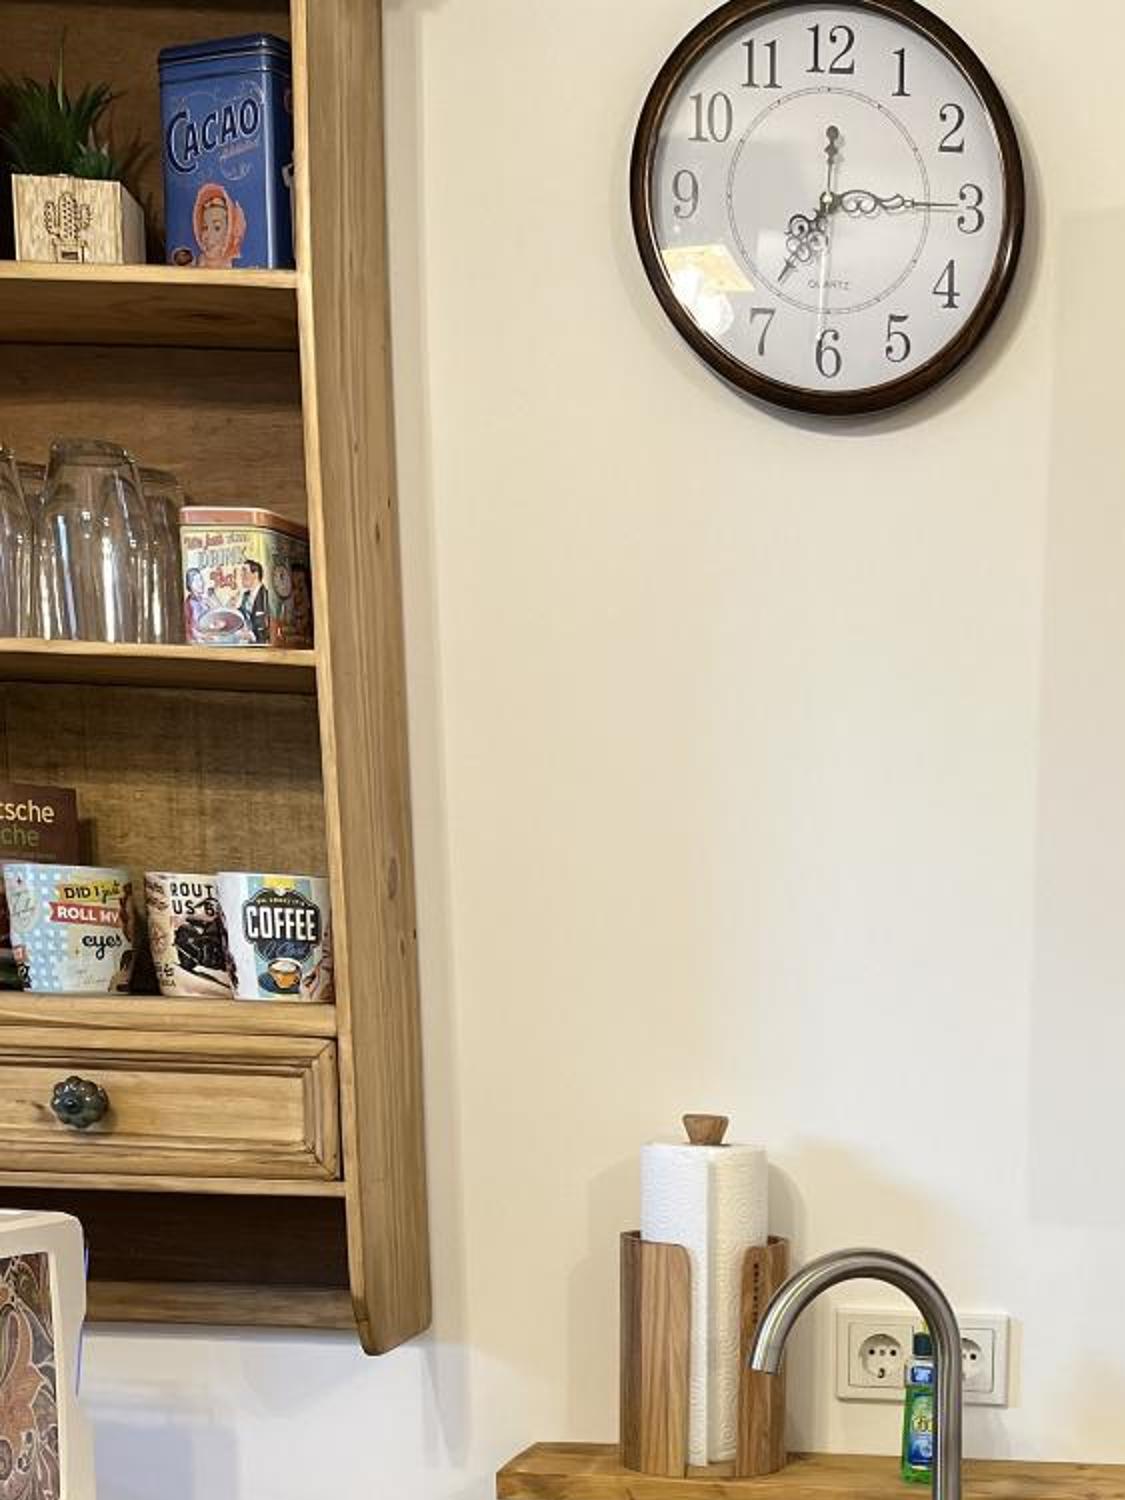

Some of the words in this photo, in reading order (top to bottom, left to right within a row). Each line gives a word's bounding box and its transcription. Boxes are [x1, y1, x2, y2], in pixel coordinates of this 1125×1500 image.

[741, 39, 783, 89] 11
[805, 24, 855, 75] 12
[891, 47, 911, 97] 1
[167, 97, 260, 174] CACAO
[688, 91, 733, 143] 10
[938, 103, 965, 153] 2
[673, 169, 699, 219] 9
[957, 183, 984, 234] 3
[932, 259, 961, 309] 4
[749, 307, 776, 356] 7
[815, 329, 842, 378] 6
[885, 314, 911, 363] 5
[57, 904, 98, 921] ROLL
[100, 910, 119, 922] MY
[64, 886, 92, 899] DID
[170, 883, 220, 899] ROUT
[172, 900, 196, 916] US
[82, 934, 123, 961] eyes
[246, 905, 317, 941] COFFEE
